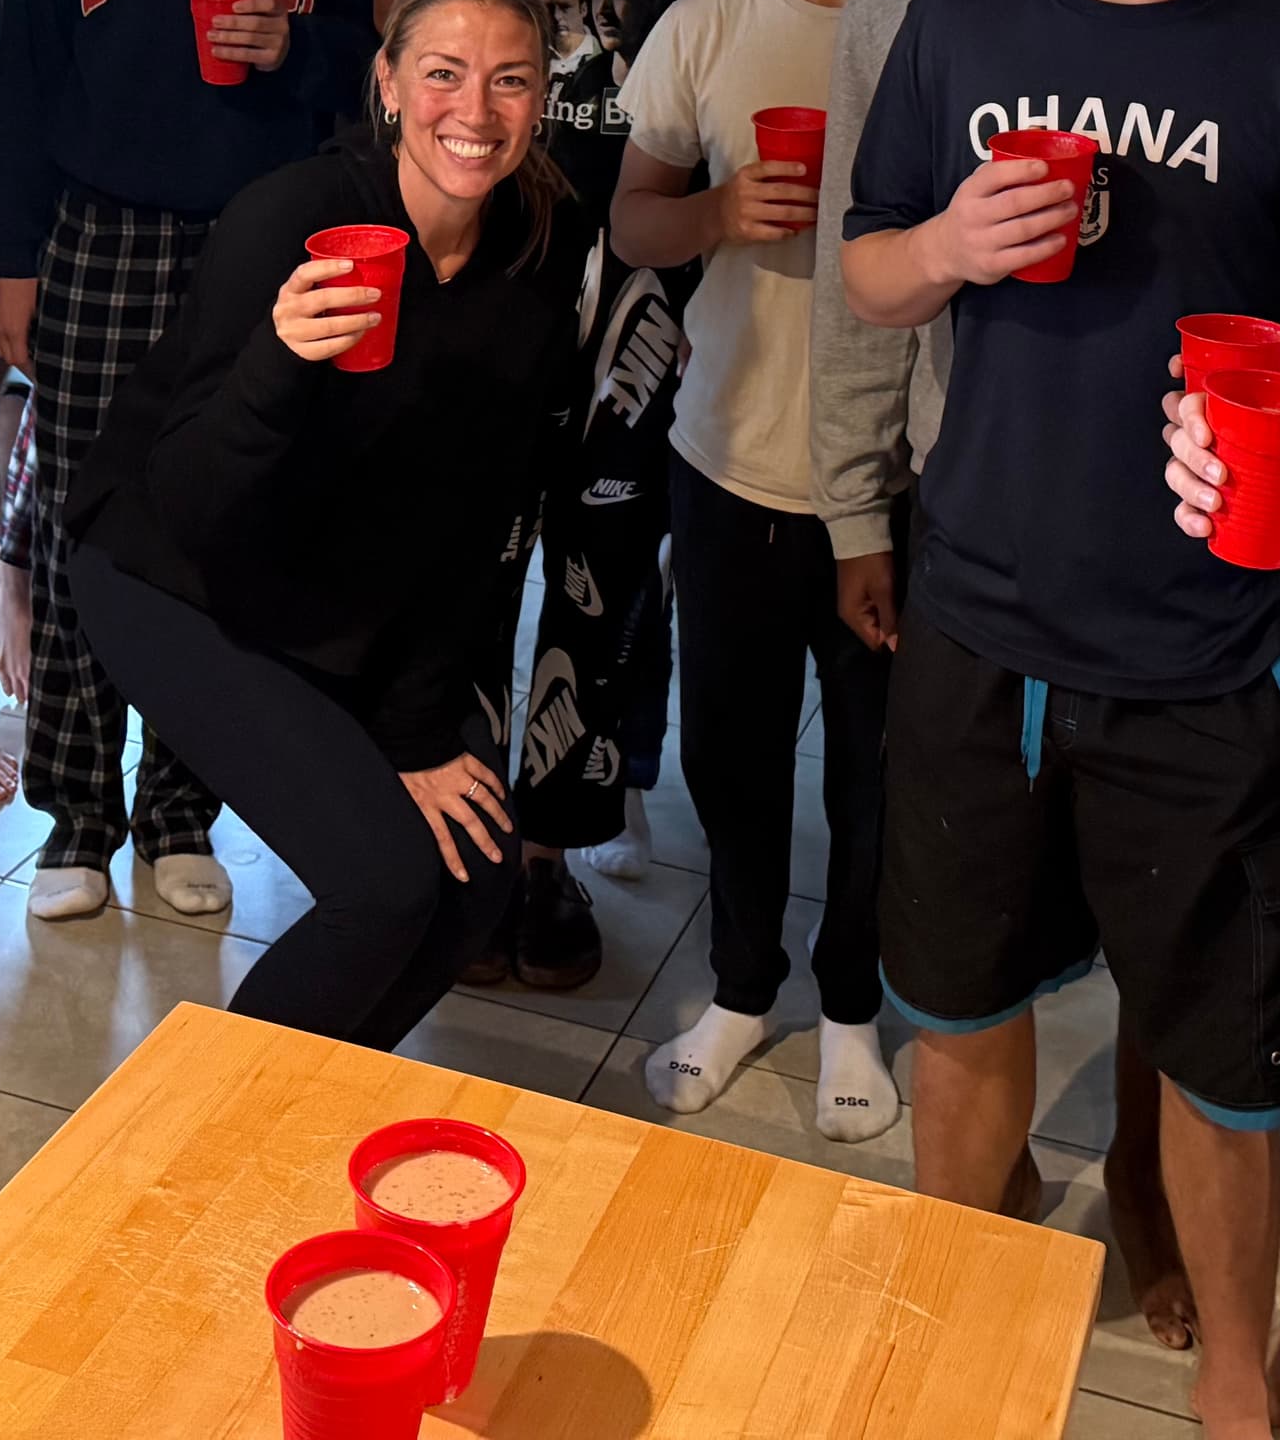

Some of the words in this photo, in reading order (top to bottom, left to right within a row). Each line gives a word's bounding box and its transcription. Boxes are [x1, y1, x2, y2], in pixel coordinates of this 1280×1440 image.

[968, 94, 1219, 184] OHANA
[599, 300, 683, 430] NIKE
[591, 478, 637, 497] NIKE
[524, 687, 587, 789] NIKE
